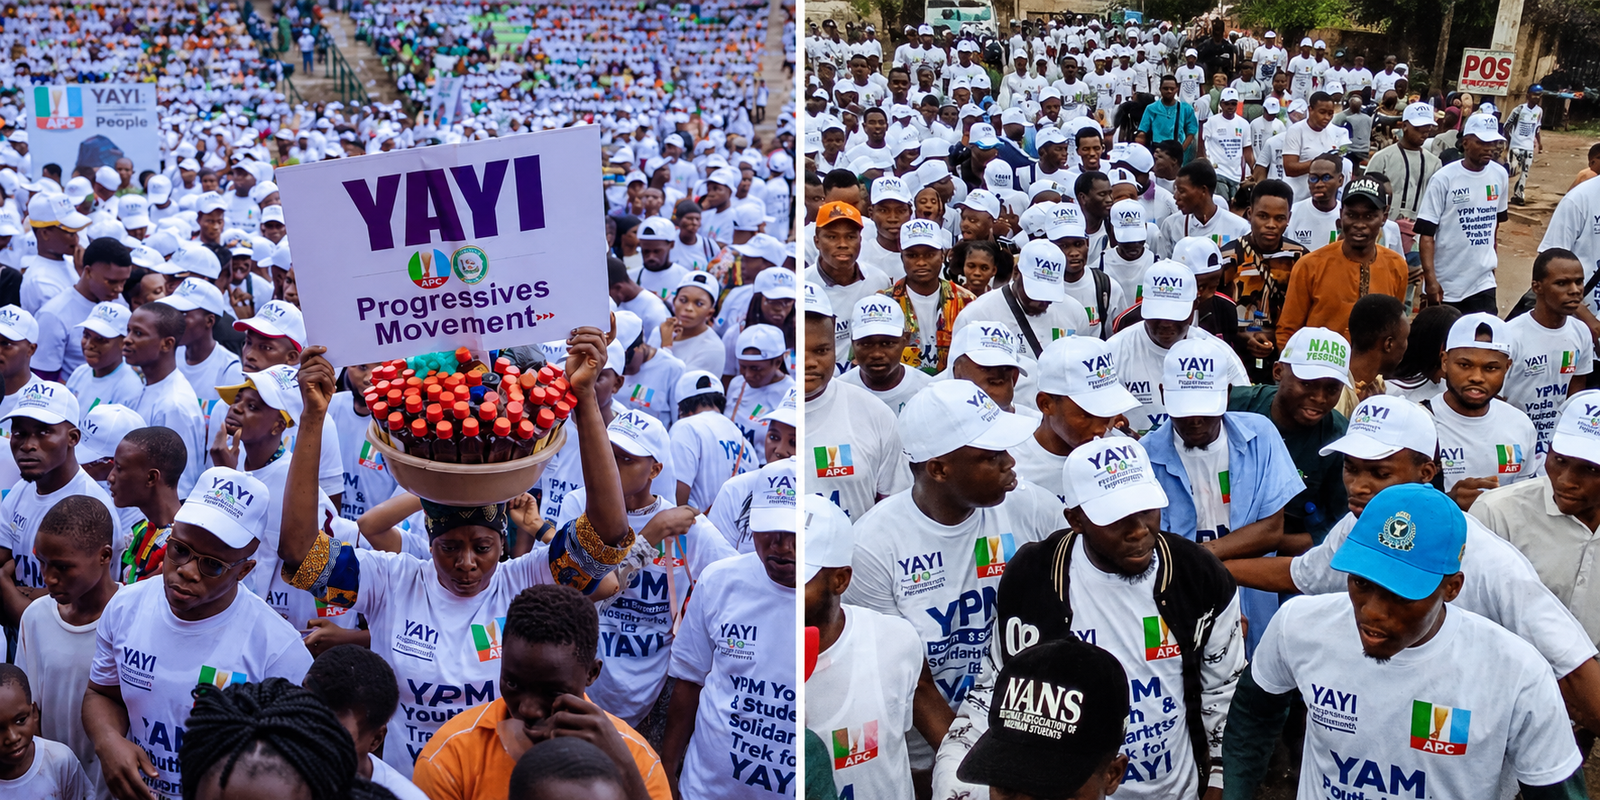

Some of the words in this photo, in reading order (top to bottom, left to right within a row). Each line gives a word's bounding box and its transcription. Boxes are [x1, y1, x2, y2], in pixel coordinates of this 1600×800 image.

[1463, 55, 1511, 80] POS
[46, 117, 76, 129] APC
[96, 117, 148, 130] People
[341, 154, 546, 252] YAYI
[1053, 208, 1079, 218] YAYI
[1118, 211, 1141, 219] YAYI
[906, 222, 934, 231] YAYI
[1035, 257, 1062, 272] YAYI
[421, 278, 442, 288] APC
[1153, 276, 1182, 288] YAYI
[357, 280, 550, 321] Progressives
[861, 304, 891, 314] YAYI
[375, 305, 537, 345] Movement
[981, 326, 1013, 344] YAYI
[1309, 338, 1346, 359] NARS
[1082, 352, 1114, 373] YAYI
[1178, 357, 1214, 373] YAYI
[1525, 355, 1548, 367] YAYI
[23, 384, 54, 398] YAYI
[617, 413, 650, 431] YAYI
[1088, 445, 1137, 470] YAYI
[1439, 448, 1464, 460] AYI
[826, 467, 847, 477] APC
[212, 477, 254, 507] YAYI
[898, 552, 943, 576] YAYI
[266, 592, 288, 606] AYI
[405, 619, 438, 645] YAYI
[720, 623, 757, 641] YAYI
[123, 646, 157, 672] YAYI
[1156, 645, 1181, 659] APC
[729, 674, 766, 697] YPM
[730, 695, 740, 710] &
[1000, 677, 1084, 725] NANS
[1162, 696, 1177, 714] &
[1311, 683, 1357, 715] YAYI
[1067, 724, 1078, 735] OF
[731, 731, 775, 763] Trek
[1142, 738, 1169, 759] for
[1422, 739, 1455, 755] APC
[845, 751, 871, 767] APC
[1119, 751, 1172, 786] AYI
[1330, 749, 1426, 800] YAM
